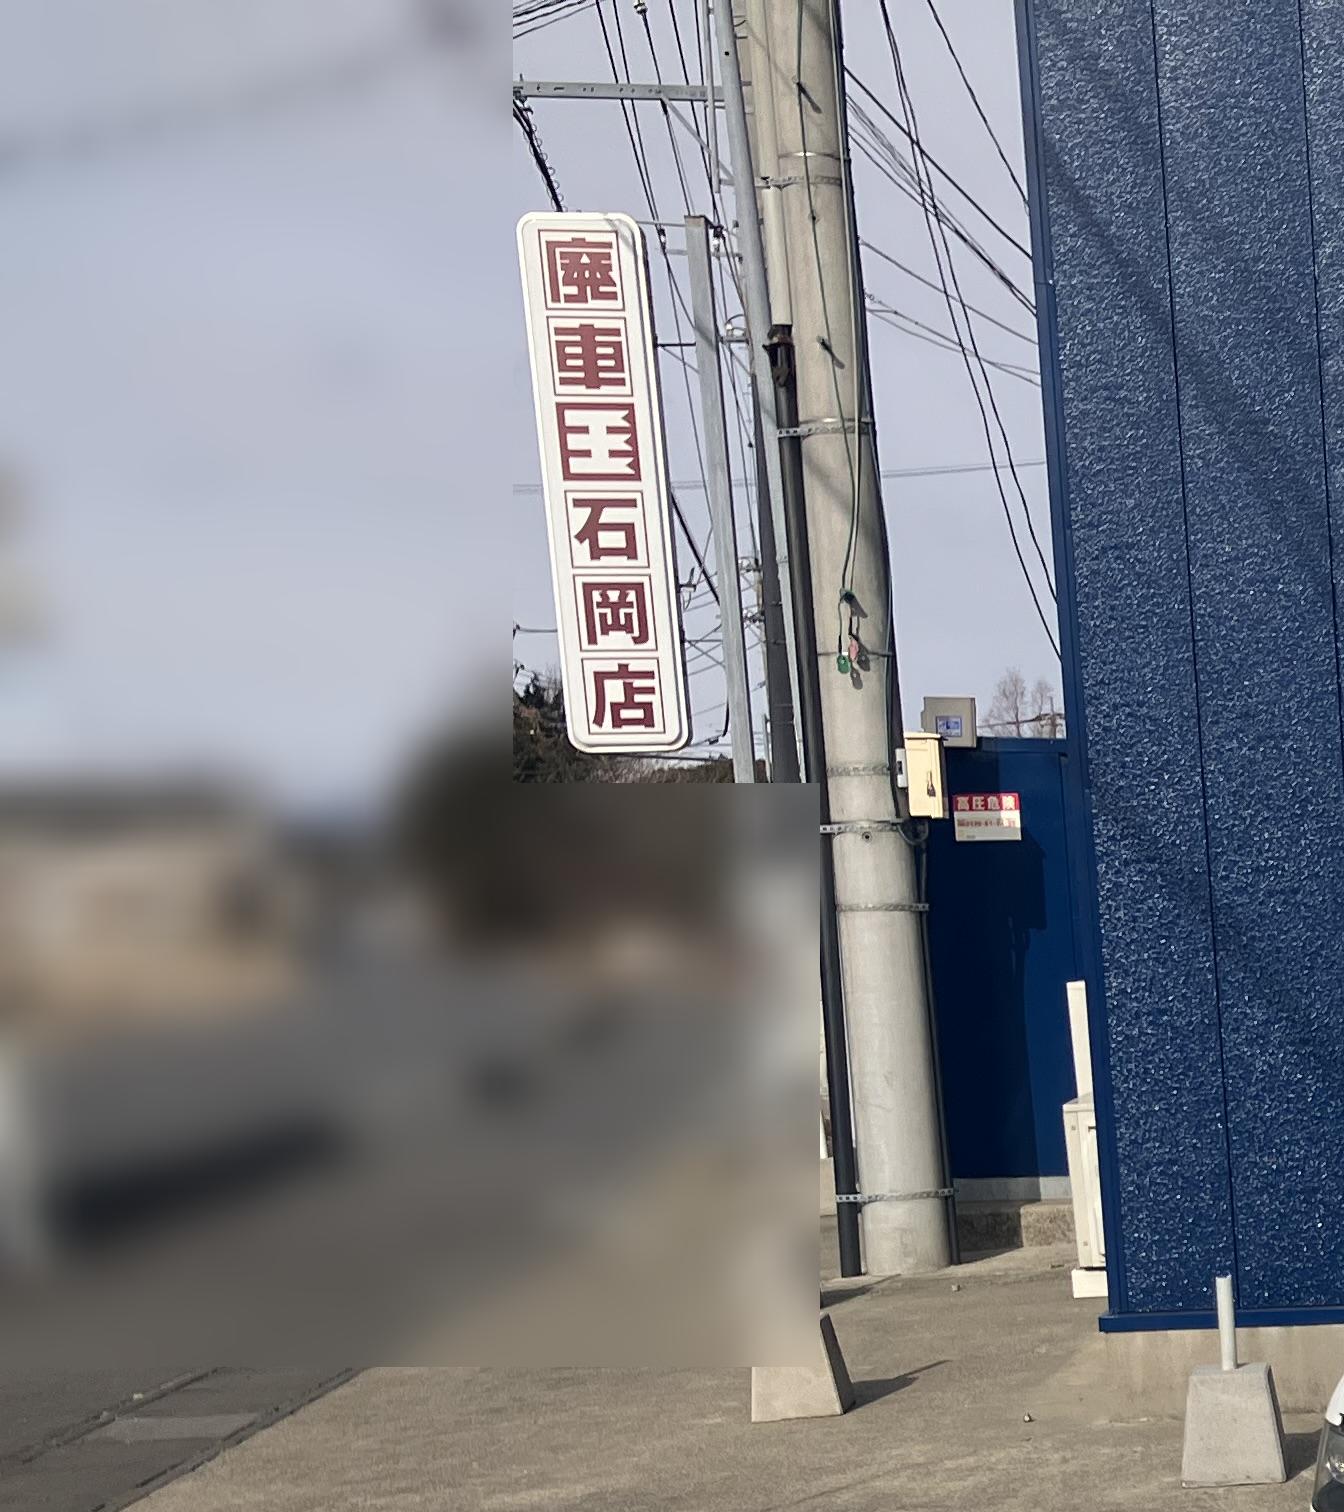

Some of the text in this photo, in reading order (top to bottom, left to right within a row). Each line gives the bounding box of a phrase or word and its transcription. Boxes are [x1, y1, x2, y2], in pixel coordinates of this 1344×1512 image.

[544, 237, 656, 729] 廃車王石岡店
